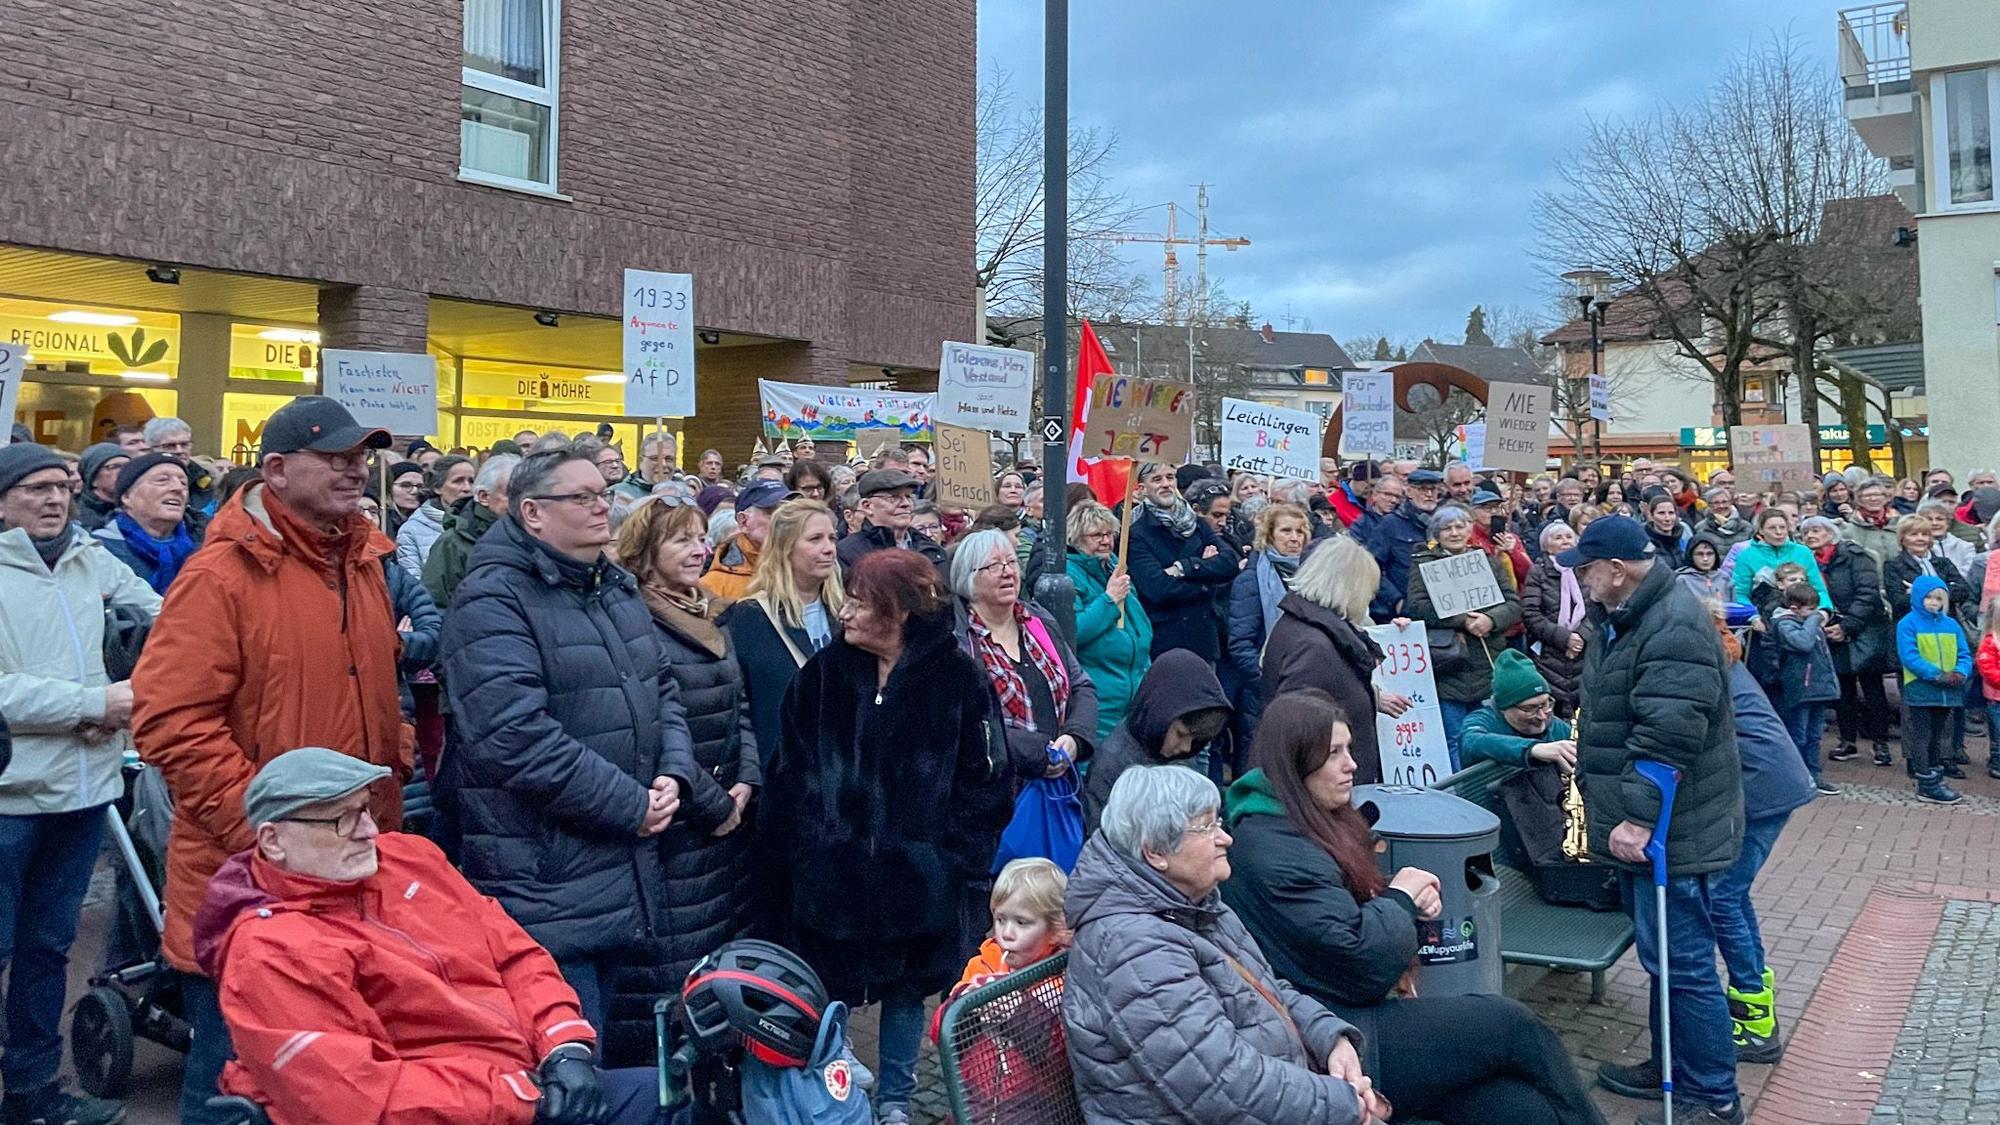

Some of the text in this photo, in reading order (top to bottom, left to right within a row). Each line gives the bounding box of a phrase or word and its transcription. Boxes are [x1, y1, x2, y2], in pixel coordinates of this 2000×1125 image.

[633, 287, 687, 310] 1933
[265, 344, 293, 365] DIE
[640, 340, 674, 353] gegen
[391, 381, 429, 395] NICHT
[518, 380, 591, 399] DIE MÖHRE
[631, 367, 680, 393] AfD
[1347, 376, 1376, 391] Für
[1504, 391, 1536, 415] NIE
[466, 422, 500, 437] OBST
[1226, 403, 1311, 436] Leichlingen
[1345, 415, 1389, 438] Gegen
[1499, 418, 1537, 432] WIEDER
[941, 429, 966, 453] Sei
[1101, 430, 1169, 456] JETZT
[1255, 430, 1290, 452] Bunt
[1498, 437, 1535, 454] RECHTS
[942, 455, 967, 474] ein
[1227, 454, 1314, 481] statt Braun
[941, 477, 991, 503] Mensch
[1395, 721, 1425, 745] gegen
[1402, 743, 1422, 757] die
